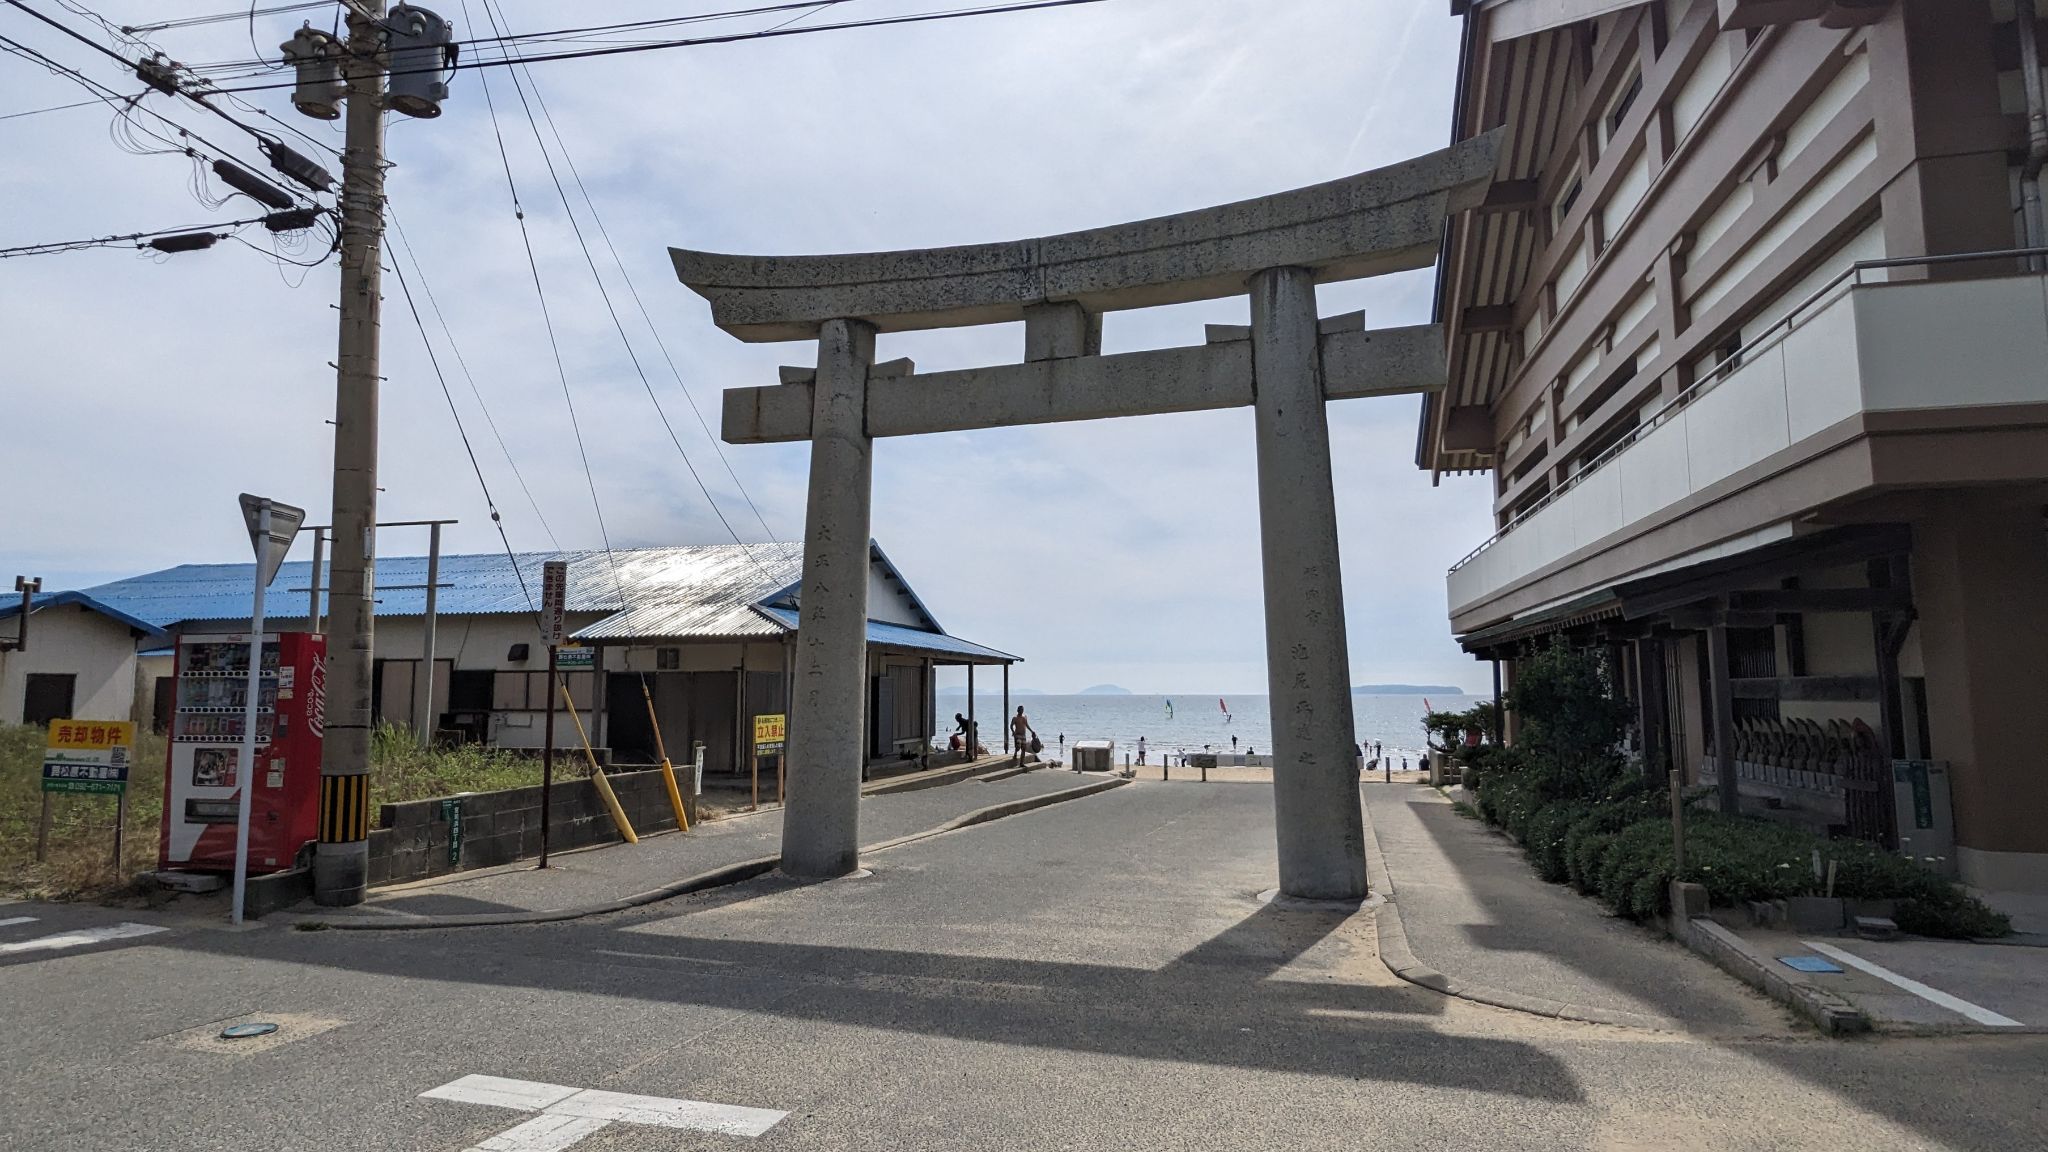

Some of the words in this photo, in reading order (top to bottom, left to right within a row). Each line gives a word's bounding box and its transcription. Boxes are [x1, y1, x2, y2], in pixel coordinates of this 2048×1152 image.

[544, 567, 554, 608] できません
[58, 726, 122, 744] 売却物件
[757, 724, 784, 738] 立入禁止
